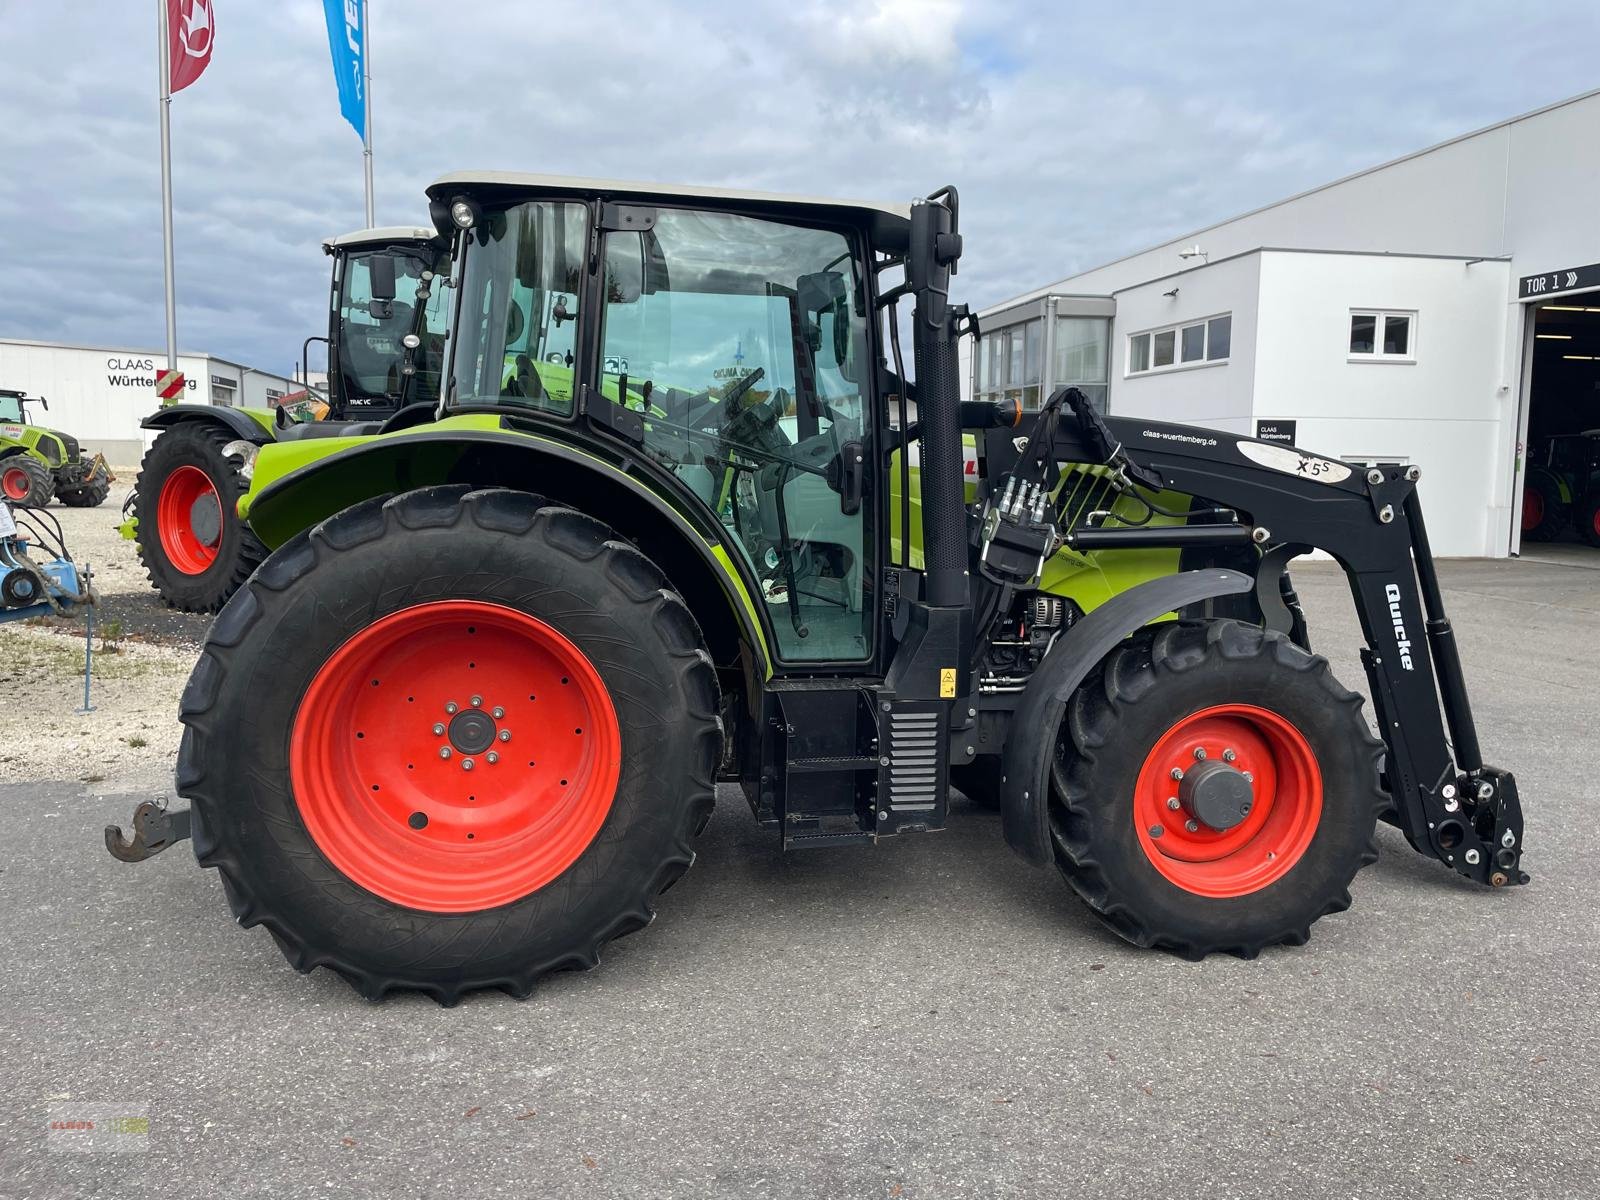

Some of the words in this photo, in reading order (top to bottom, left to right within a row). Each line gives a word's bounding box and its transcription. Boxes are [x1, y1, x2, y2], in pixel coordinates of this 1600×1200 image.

[1526, 277, 1546, 294] TOR
[1552, 274, 1559, 290] 1
[107, 358, 154, 371] CLAAS
[108, 375, 197, 390] Württerg
[1142, 430, 1217, 446] claas-wuerttemberg.de
[1260, 433, 1291, 441] Württemberg
